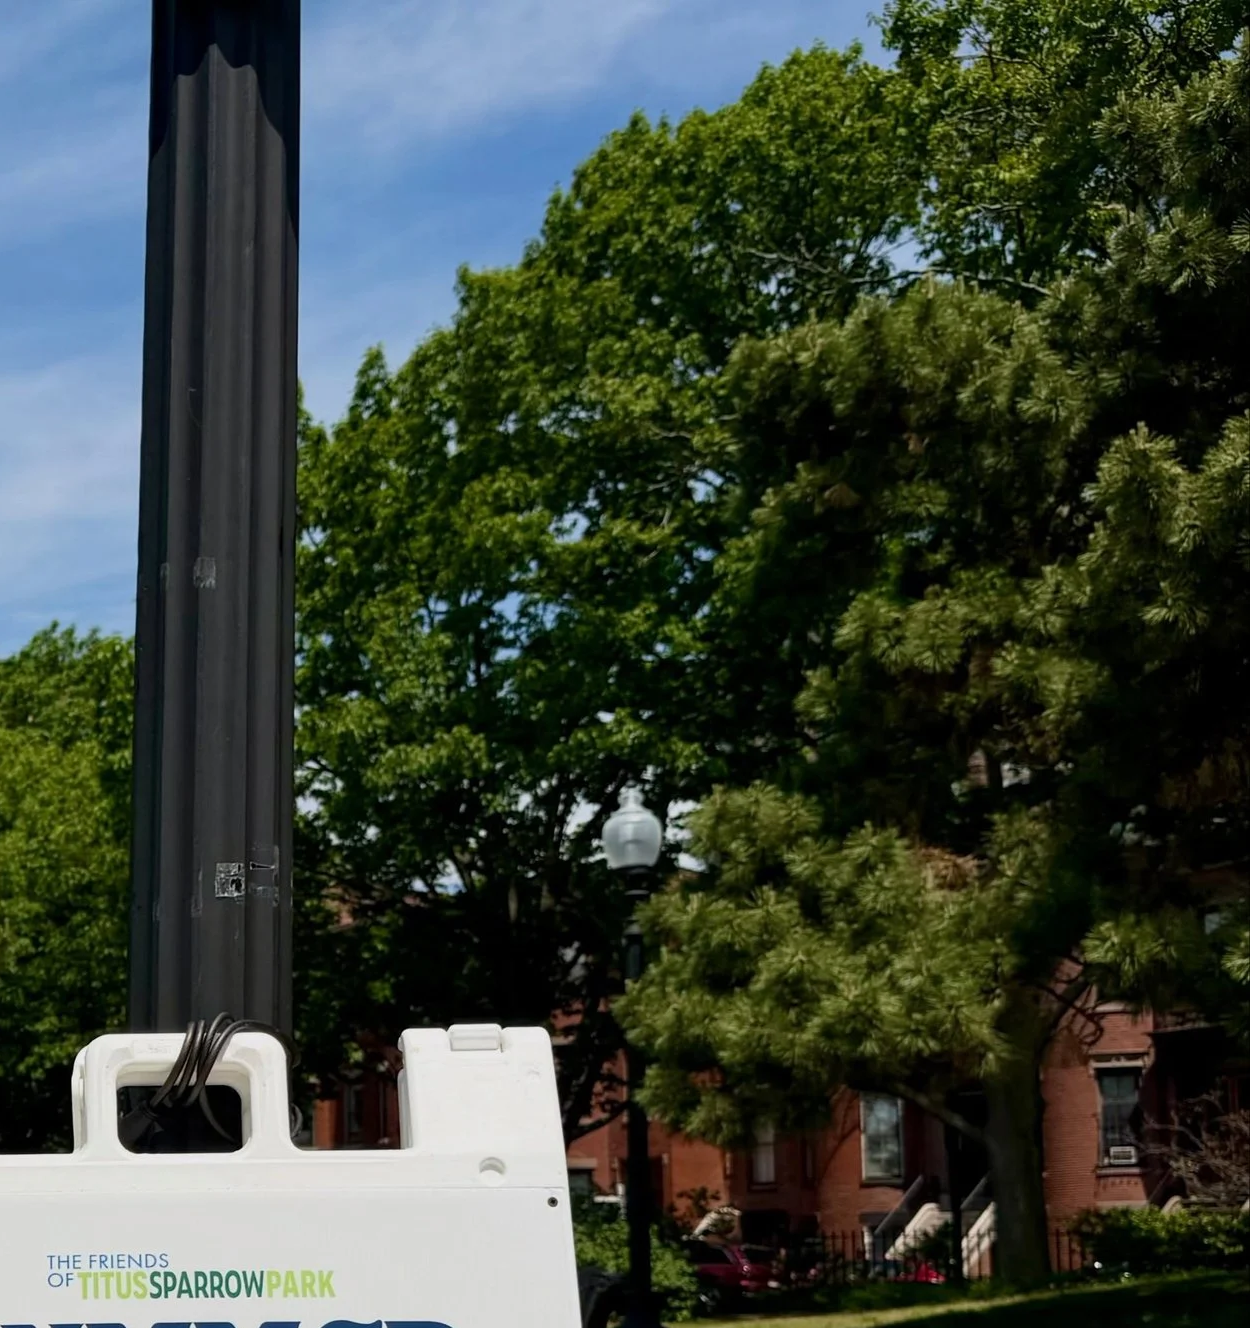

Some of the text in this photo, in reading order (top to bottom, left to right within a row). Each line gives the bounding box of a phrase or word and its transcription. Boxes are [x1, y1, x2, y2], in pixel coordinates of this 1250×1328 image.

[47, 1253, 168, 1269] THE FRIENDS
[48, 1273, 73, 1287] OF
